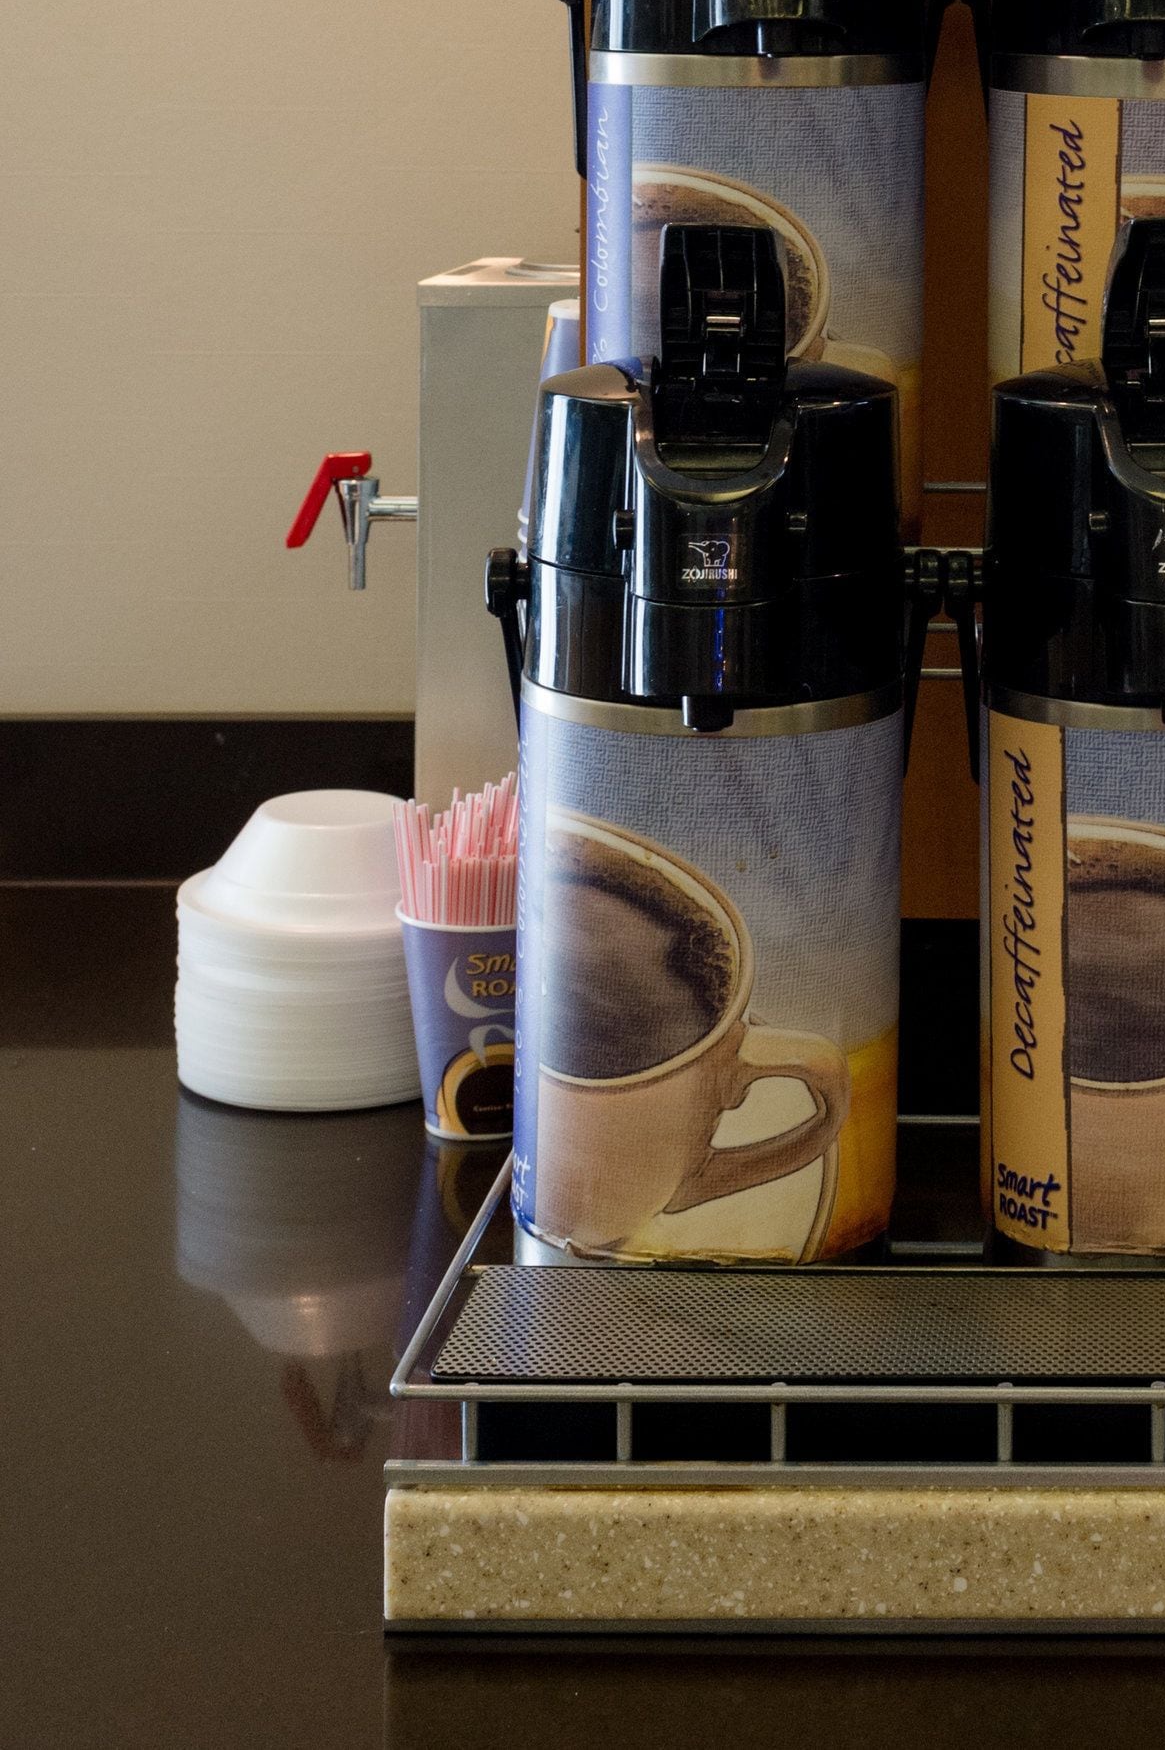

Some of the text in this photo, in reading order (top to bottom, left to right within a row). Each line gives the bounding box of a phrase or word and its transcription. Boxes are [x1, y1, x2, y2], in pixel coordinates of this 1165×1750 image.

[681, 566, 738, 582] ZOJIRUSHI
[1003, 748, 1041, 1082] Decaffeinated
[997, 1162, 1061, 1208] Smart
